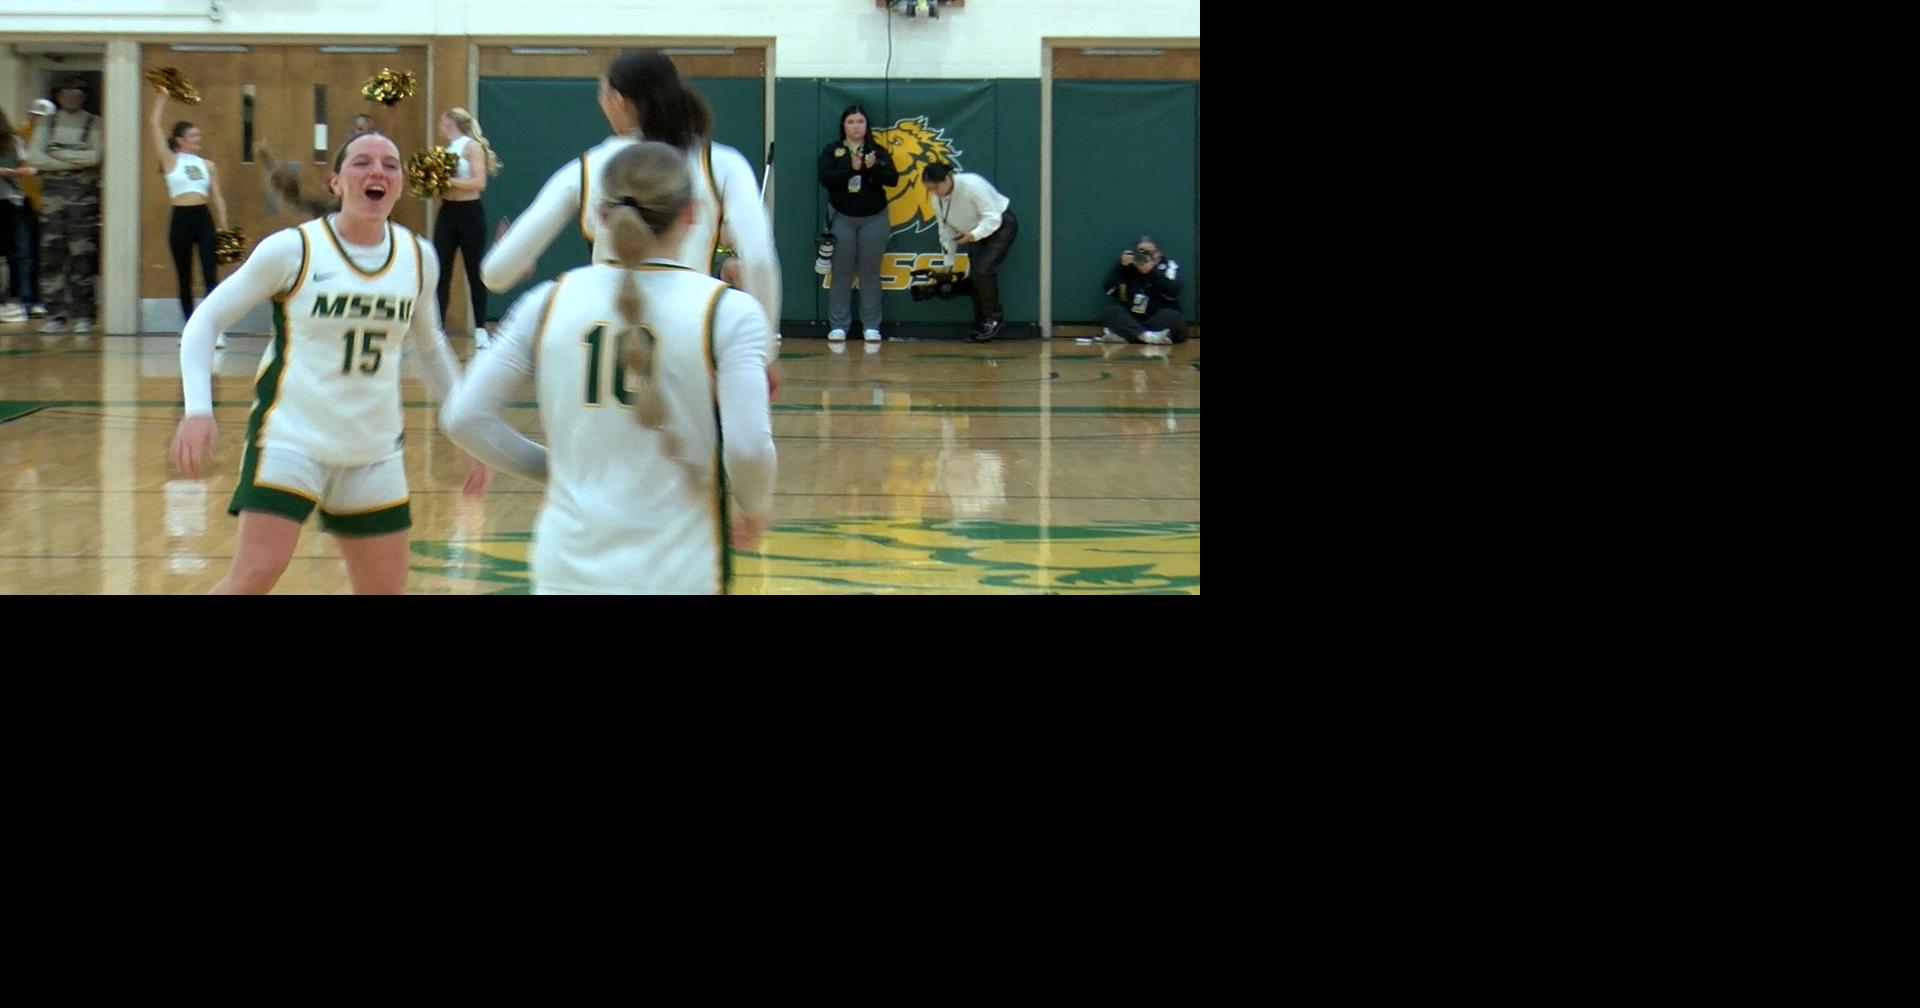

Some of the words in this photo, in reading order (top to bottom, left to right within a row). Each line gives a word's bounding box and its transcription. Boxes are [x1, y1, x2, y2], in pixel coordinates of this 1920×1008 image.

[311, 294, 412, 321] MSSU
[342, 328, 388, 376] 15
[580, 321, 660, 408] 10
